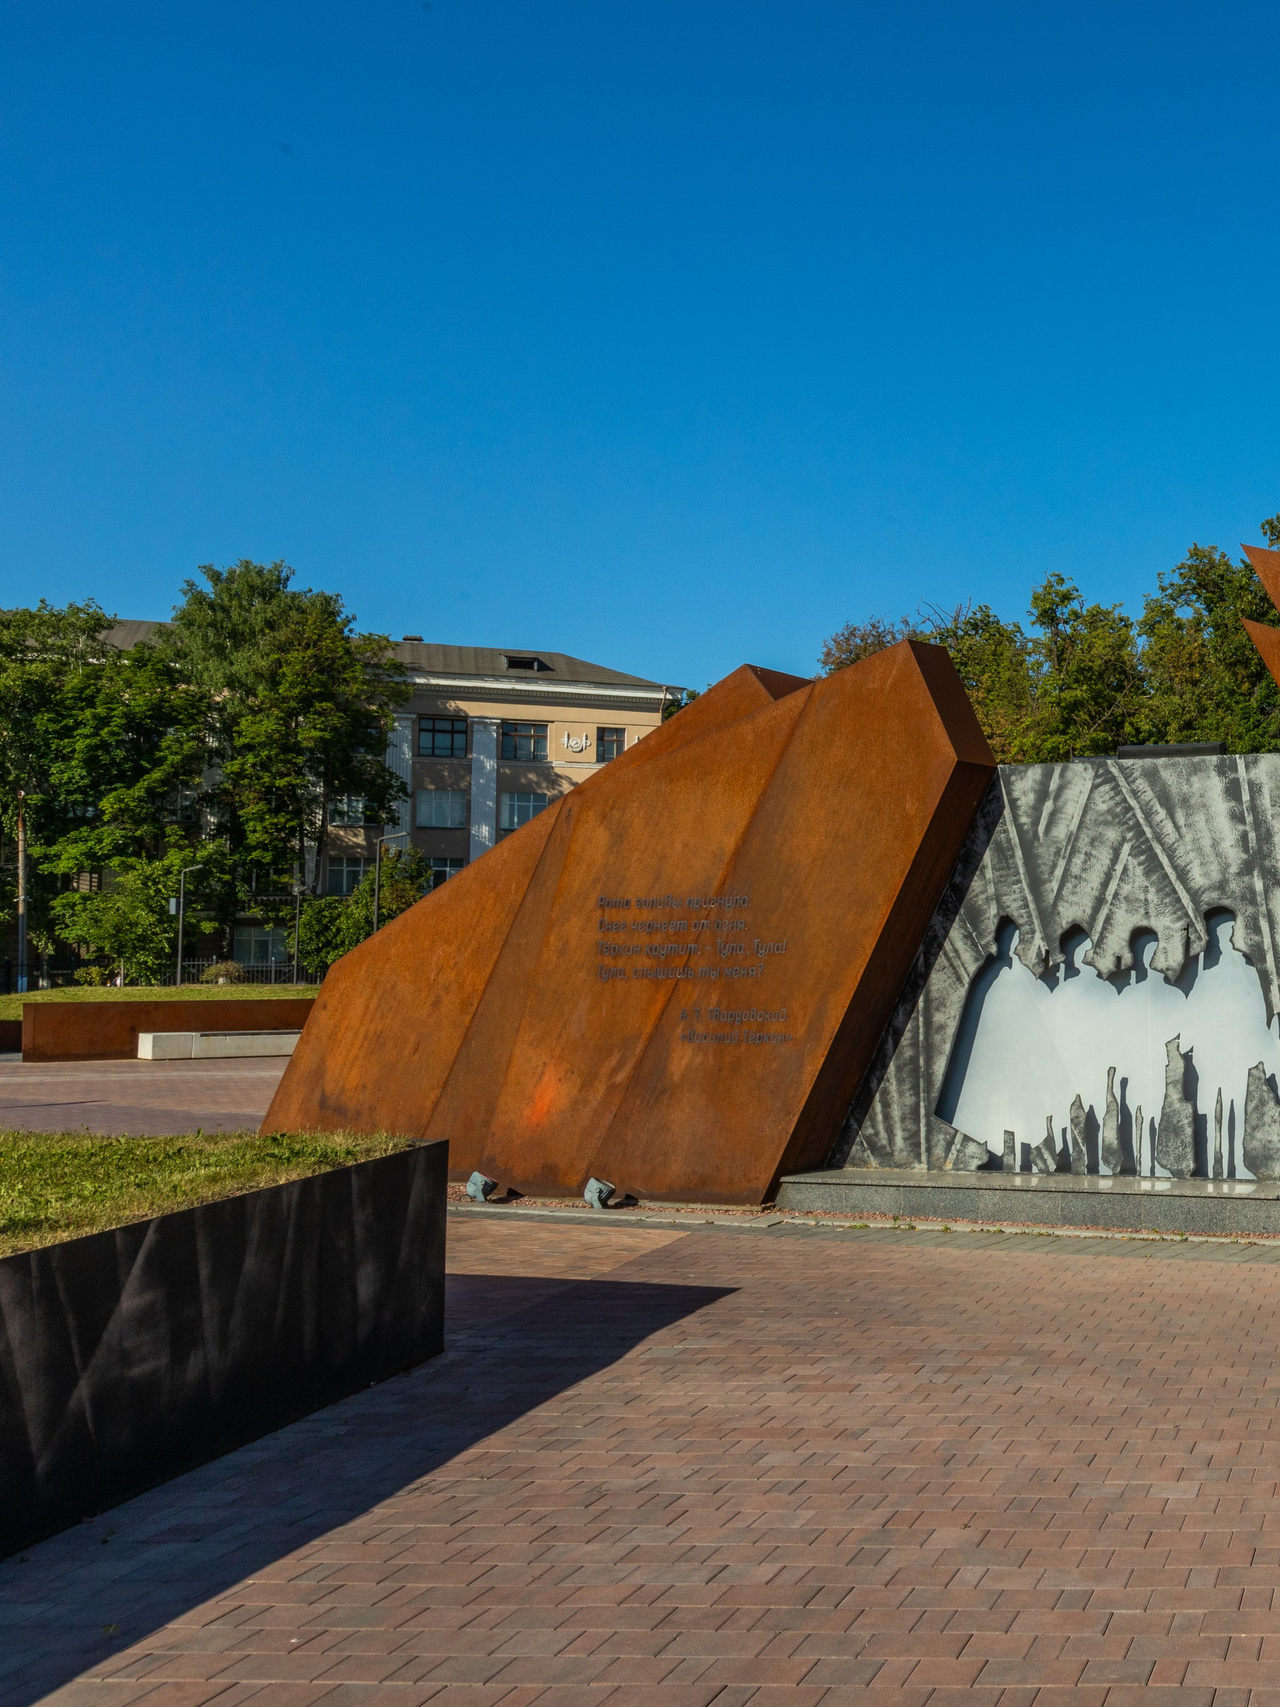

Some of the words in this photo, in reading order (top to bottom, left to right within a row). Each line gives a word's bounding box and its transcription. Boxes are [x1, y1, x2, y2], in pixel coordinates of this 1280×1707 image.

[598, 895, 631, 909] Рота
[635, 894, 682, 909] головы
[598, 918, 627, 932] Снег
[631, 920, 688, 935] чернеет
[692, 920, 711, 931] от
[714, 918, 748, 931] огня.
[597, 941, 641, 958] Тёркин
[753, 939, 787, 957] Тула!
[597, 965, 628, 982] Тула,
[632, 967, 695, 979] слышишь
[698, 966, 720, 979] ты
[723, 962, 764, 979] меня?
[681, 1029, 740, 1043] «Василий
[743, 1029, 794, 1045] Тёркин»
